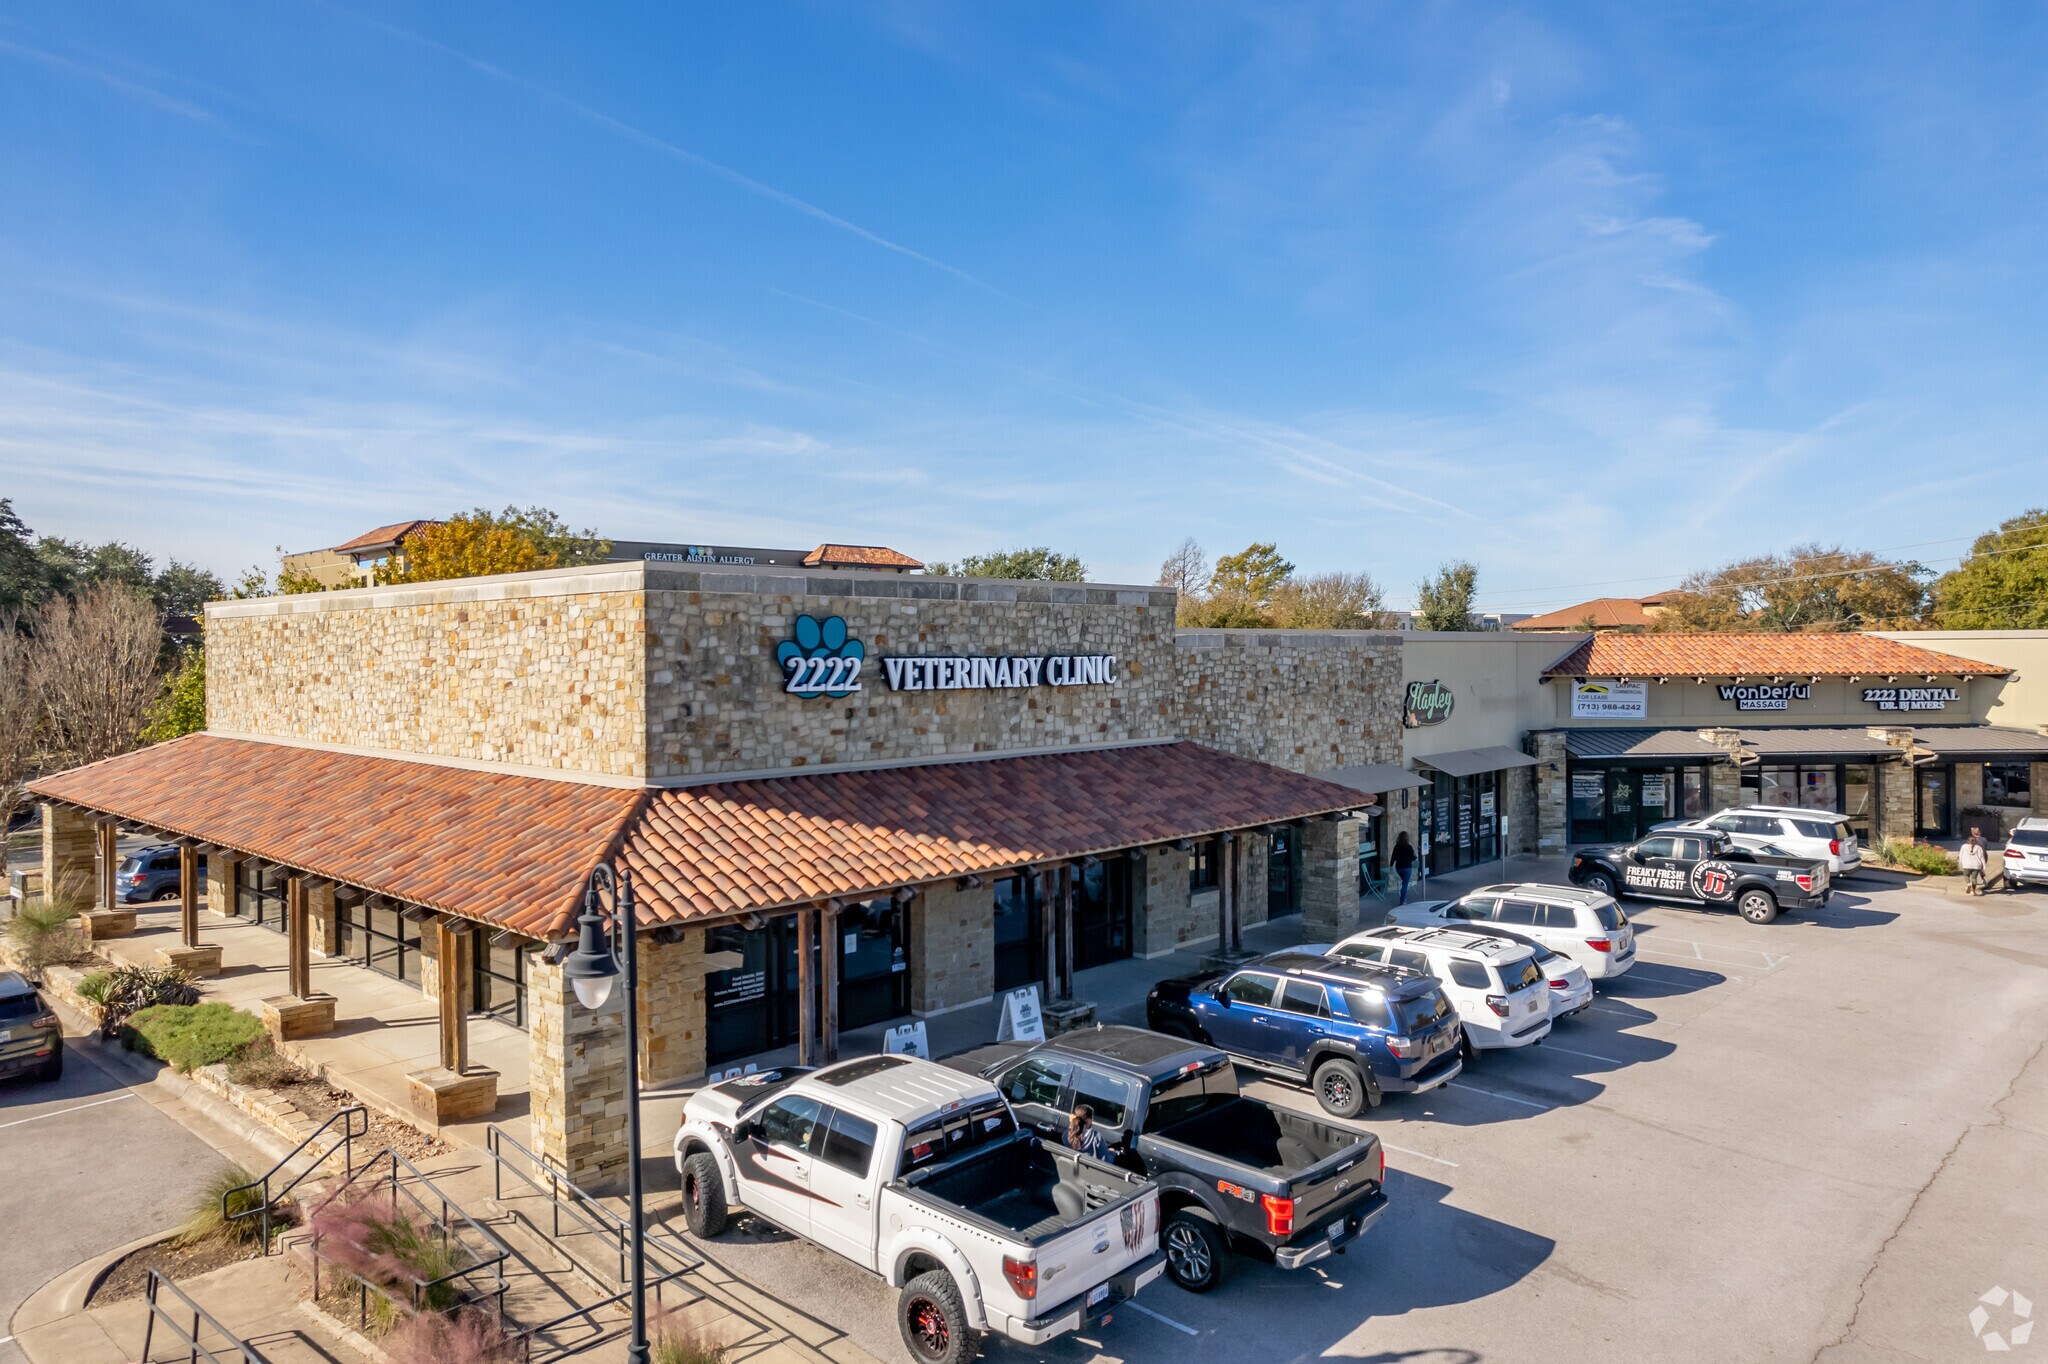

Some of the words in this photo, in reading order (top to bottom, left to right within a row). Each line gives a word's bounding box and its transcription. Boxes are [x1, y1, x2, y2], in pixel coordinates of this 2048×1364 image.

[644, 552, 683, 562] GREATER
[687, 555, 716, 563] AUSTIN
[719, 556, 755, 565] ALLERGY
[786, 656, 863, 692] 2222
[883, 656, 1044, 691] VETERINARY
[1046, 655, 1117, 686] CLINIC
[1409, 680, 1452, 719] Hayley
[1863, 689, 1896, 701] 2222
[1898, 688, 1960, 701] DENTAL
[1577, 703, 1600, 711] (713)
[1602, 703, 1641, 711] 988-4242
[1741, 700, 1787, 709] MASSAGE
[1879, 701, 1898, 710] DR.
[1900, 701, 1911, 712] BJ
[1911, 701, 1945, 710] MYERS
[1626, 866, 1657, 878] FREAKY
[1657, 868, 1685, 880] FRESH!
[1625, 876, 1659, 888] FREAKY
[1659, 878, 1685, 890] FAST!
[1703, 870, 1728, 895] JJ
[1217, 1180, 1256, 1204] FX4
